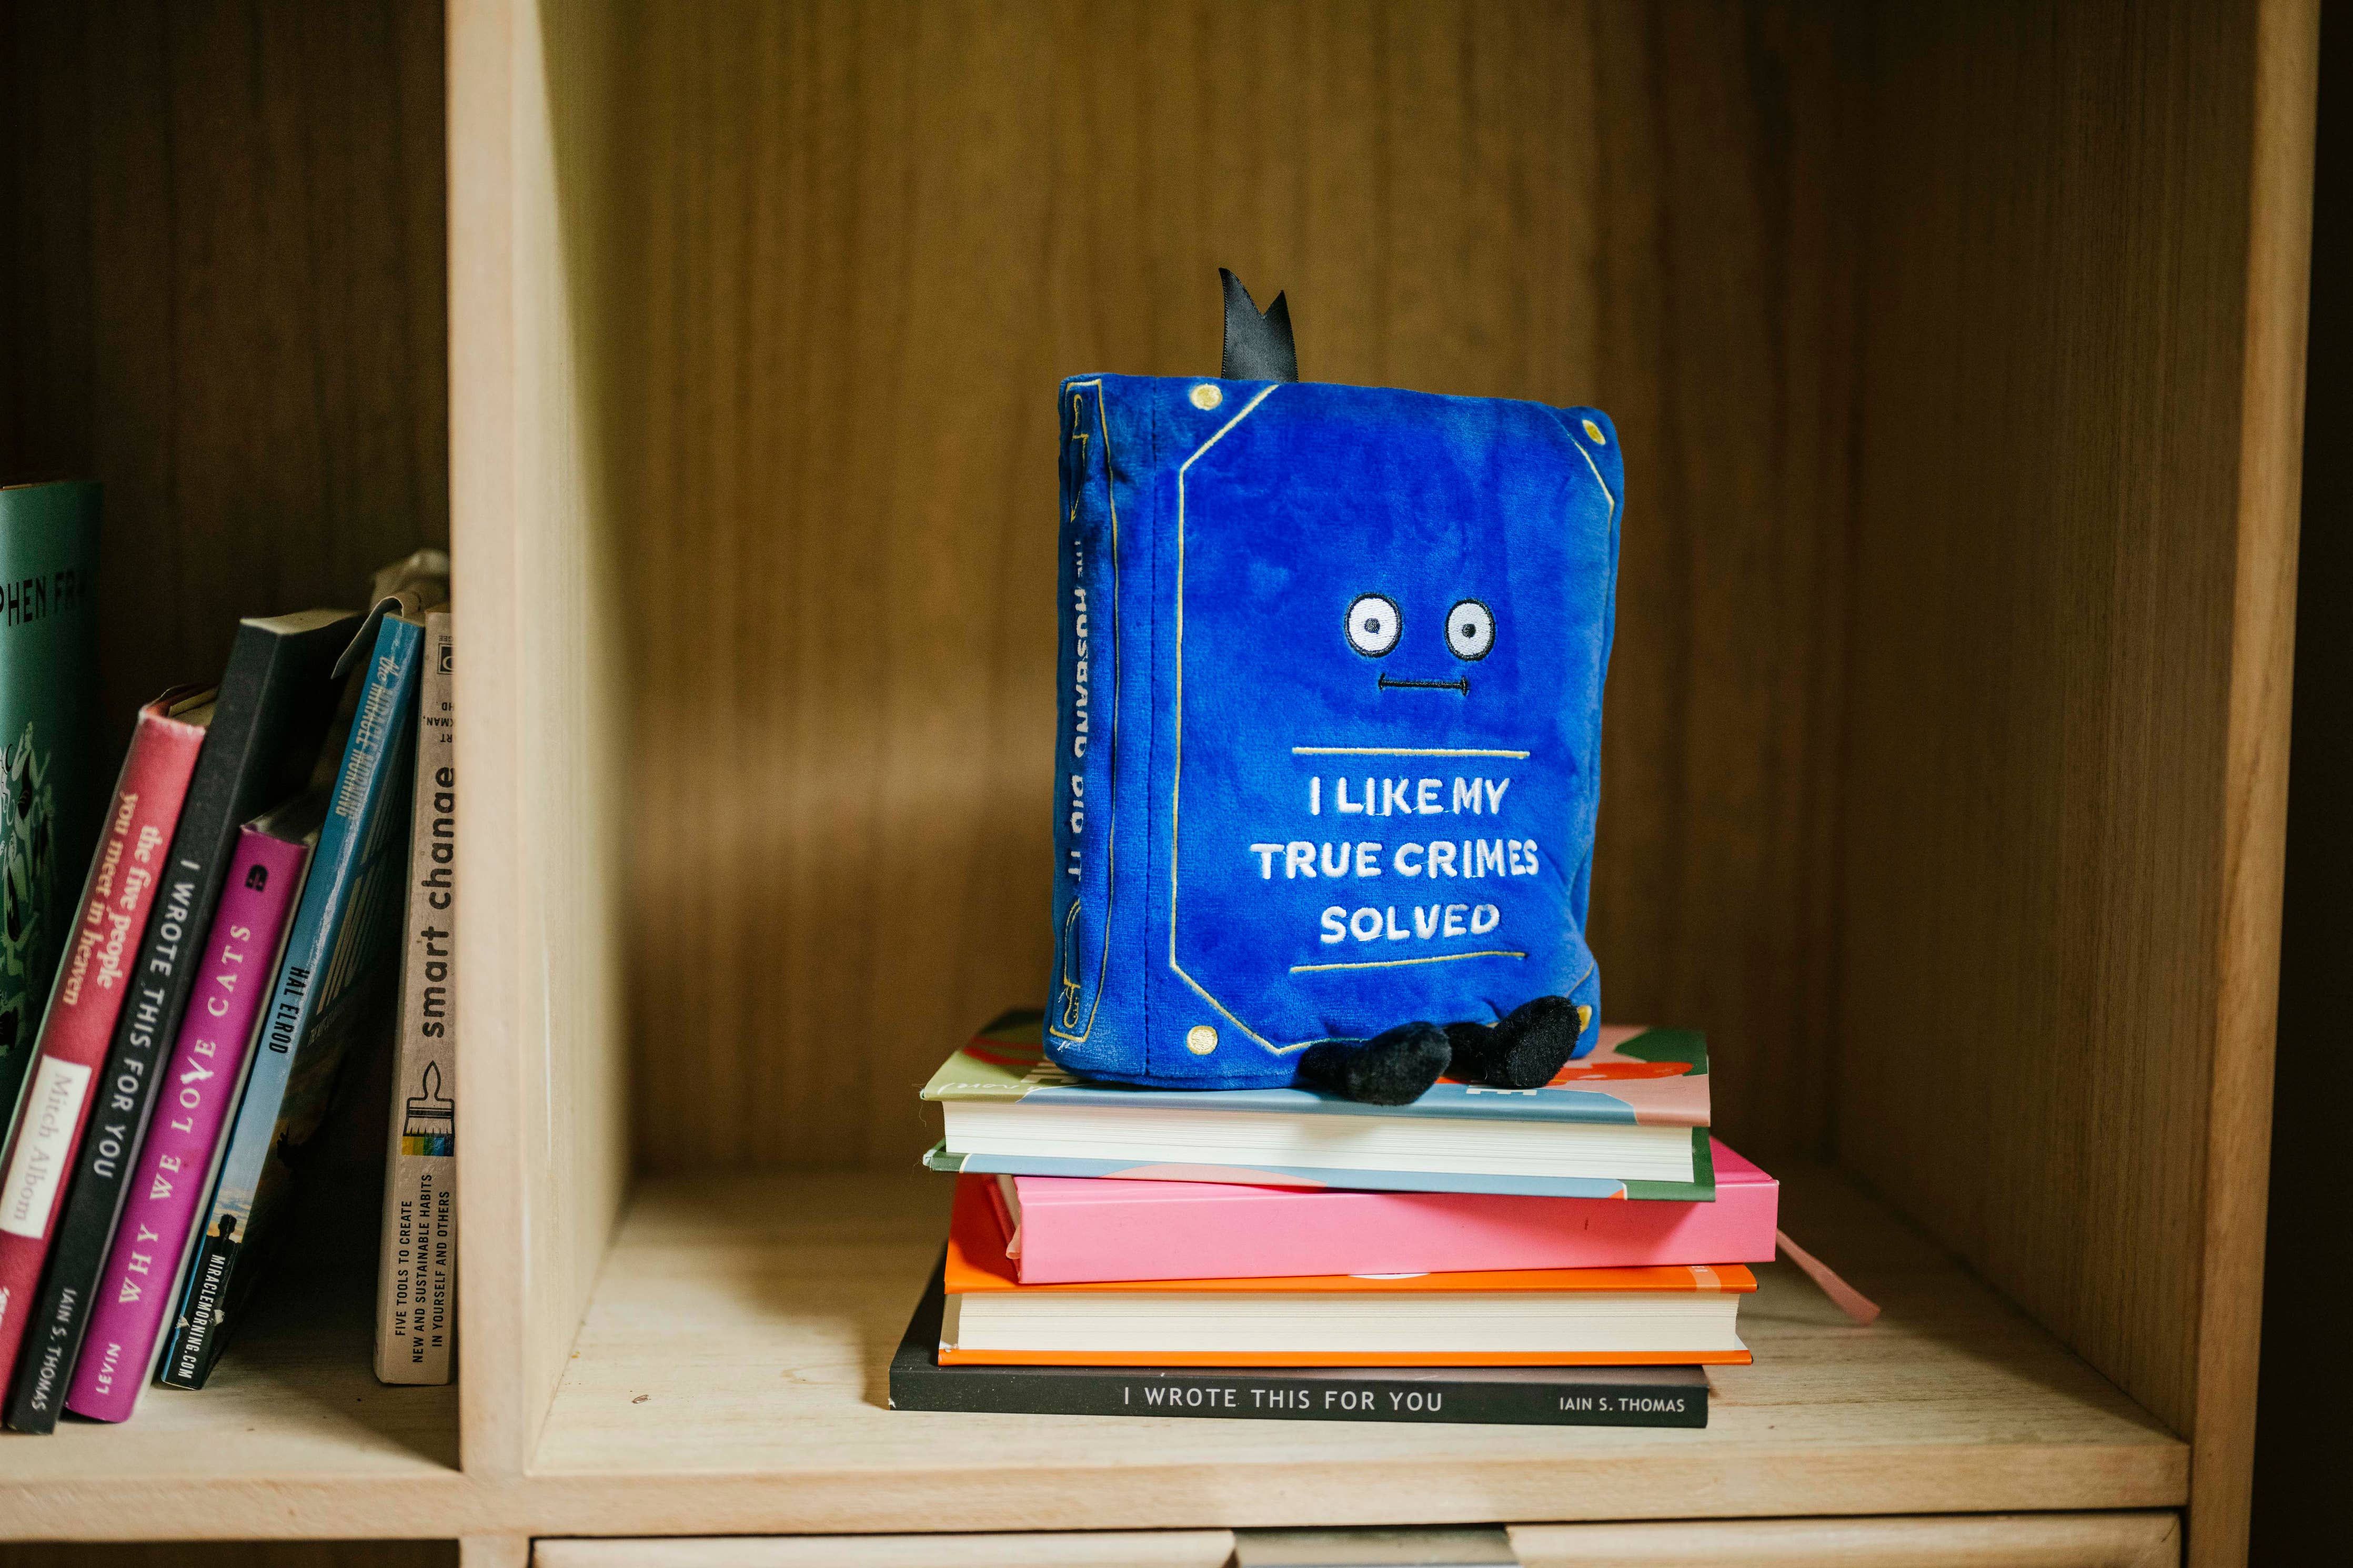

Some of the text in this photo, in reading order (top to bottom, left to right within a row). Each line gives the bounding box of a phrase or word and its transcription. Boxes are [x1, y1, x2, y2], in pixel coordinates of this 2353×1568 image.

[1074, 587, 1089, 757] HUSBAND
[1071, 774, 1084, 834] DID
[1250, 838, 1539, 879] TRUE CRIMES
[1310, 776, 1510, 817] I LIKE MY
[62, 790, 138, 1006] you meet in heaven
[96, 825, 163, 989] the five people
[1068, 851, 1081, 882] IT
[1320, 903, 1500, 944] SOLVED
[93, 859, 201, 1179] I WROTE THIS FOR YOU
[268, 965, 310, 1055] HAL ELROD
[422, 926, 449, 1038] smart
[14, 1072, 73, 1221] Mitch Albom
[118, 925, 251, 1303] WHY WE LOVE CATS
[937, 1083, 1019, 1095] novel
[177, 1253, 226, 1379] MIRACLEMORNING.COM
[395, 1200, 413, 1337] FIVE TOOLS TO CREATE
[413, 1174, 433, 1363] NEW AND SUSTAINABLE HABITS
[432, 1191, 450, 1347] IN YOURSELF AND OTHERS
[31, 1287, 78, 1411] IAIN S. THOMAS
[95, 1342, 122, 1395] LEVIN
[1125, 1387, 1685, 1413] I WROTE THIS FOR YOU IAIN S. THOMAS
